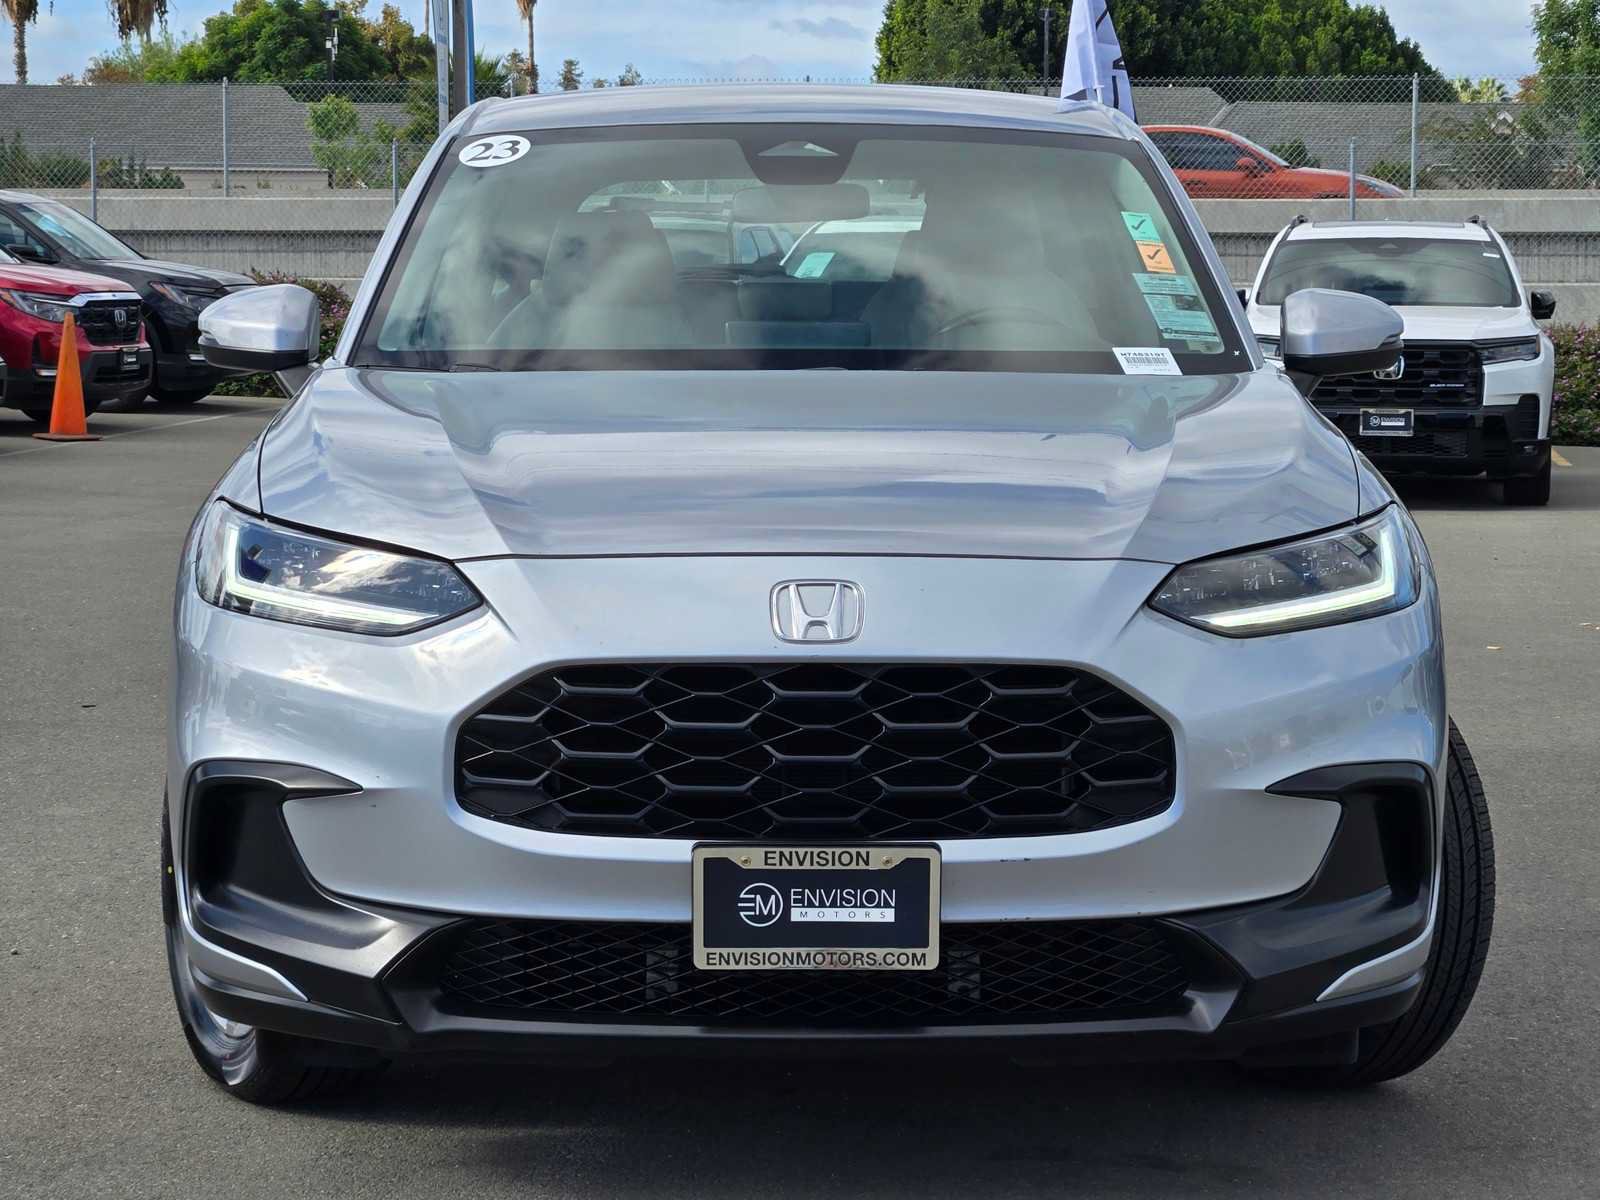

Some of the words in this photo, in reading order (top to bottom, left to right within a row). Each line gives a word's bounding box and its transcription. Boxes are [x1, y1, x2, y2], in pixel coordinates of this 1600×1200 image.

[464, 140, 521, 163] 23
[764, 850, 870, 867] ENVISION
[790, 888, 896, 907] ENVISION
[799, 910, 887, 919] MOTORS
[706, 951, 927, 967] ENVISIONMOTORS.COM
